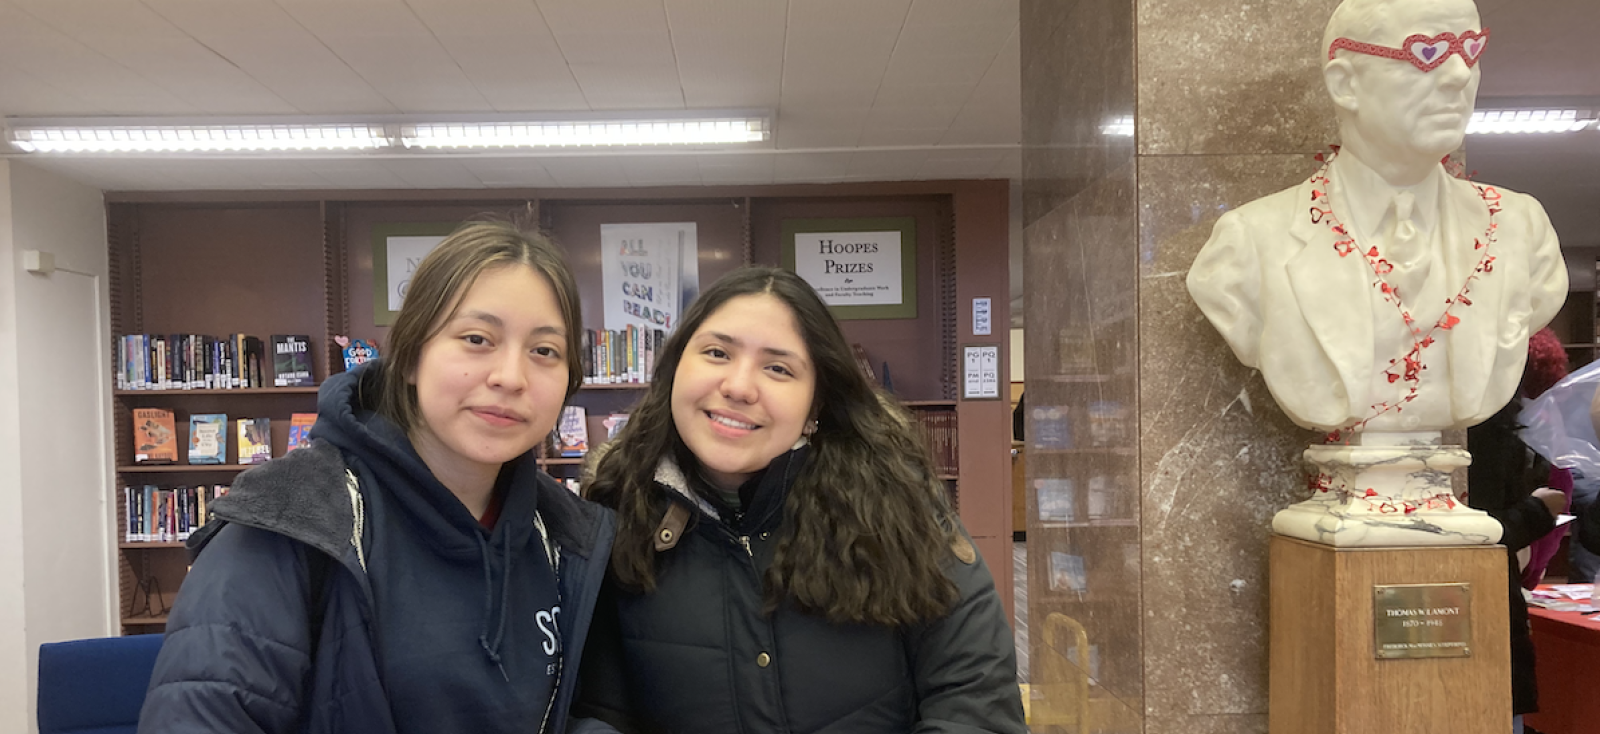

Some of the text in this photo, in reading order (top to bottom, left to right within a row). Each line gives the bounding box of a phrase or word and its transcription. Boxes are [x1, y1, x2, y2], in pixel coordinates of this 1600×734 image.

[620, 239, 648, 256] ALL
[818, 240, 878, 254] HOOPES
[620, 261, 652, 280] YOU
[824, 259, 874, 274] PRIZES
[622, 281, 653, 302] CAN
[623, 300, 671, 328] READ!
[277, 342, 307, 354] MANTIS
[138, 410, 170, 419] GASLIGHT
[1386, 608, 1418, 617] THOMAS
[1426, 607, 1460, 616] LAMONT
[536, 606, 561, 656] S
